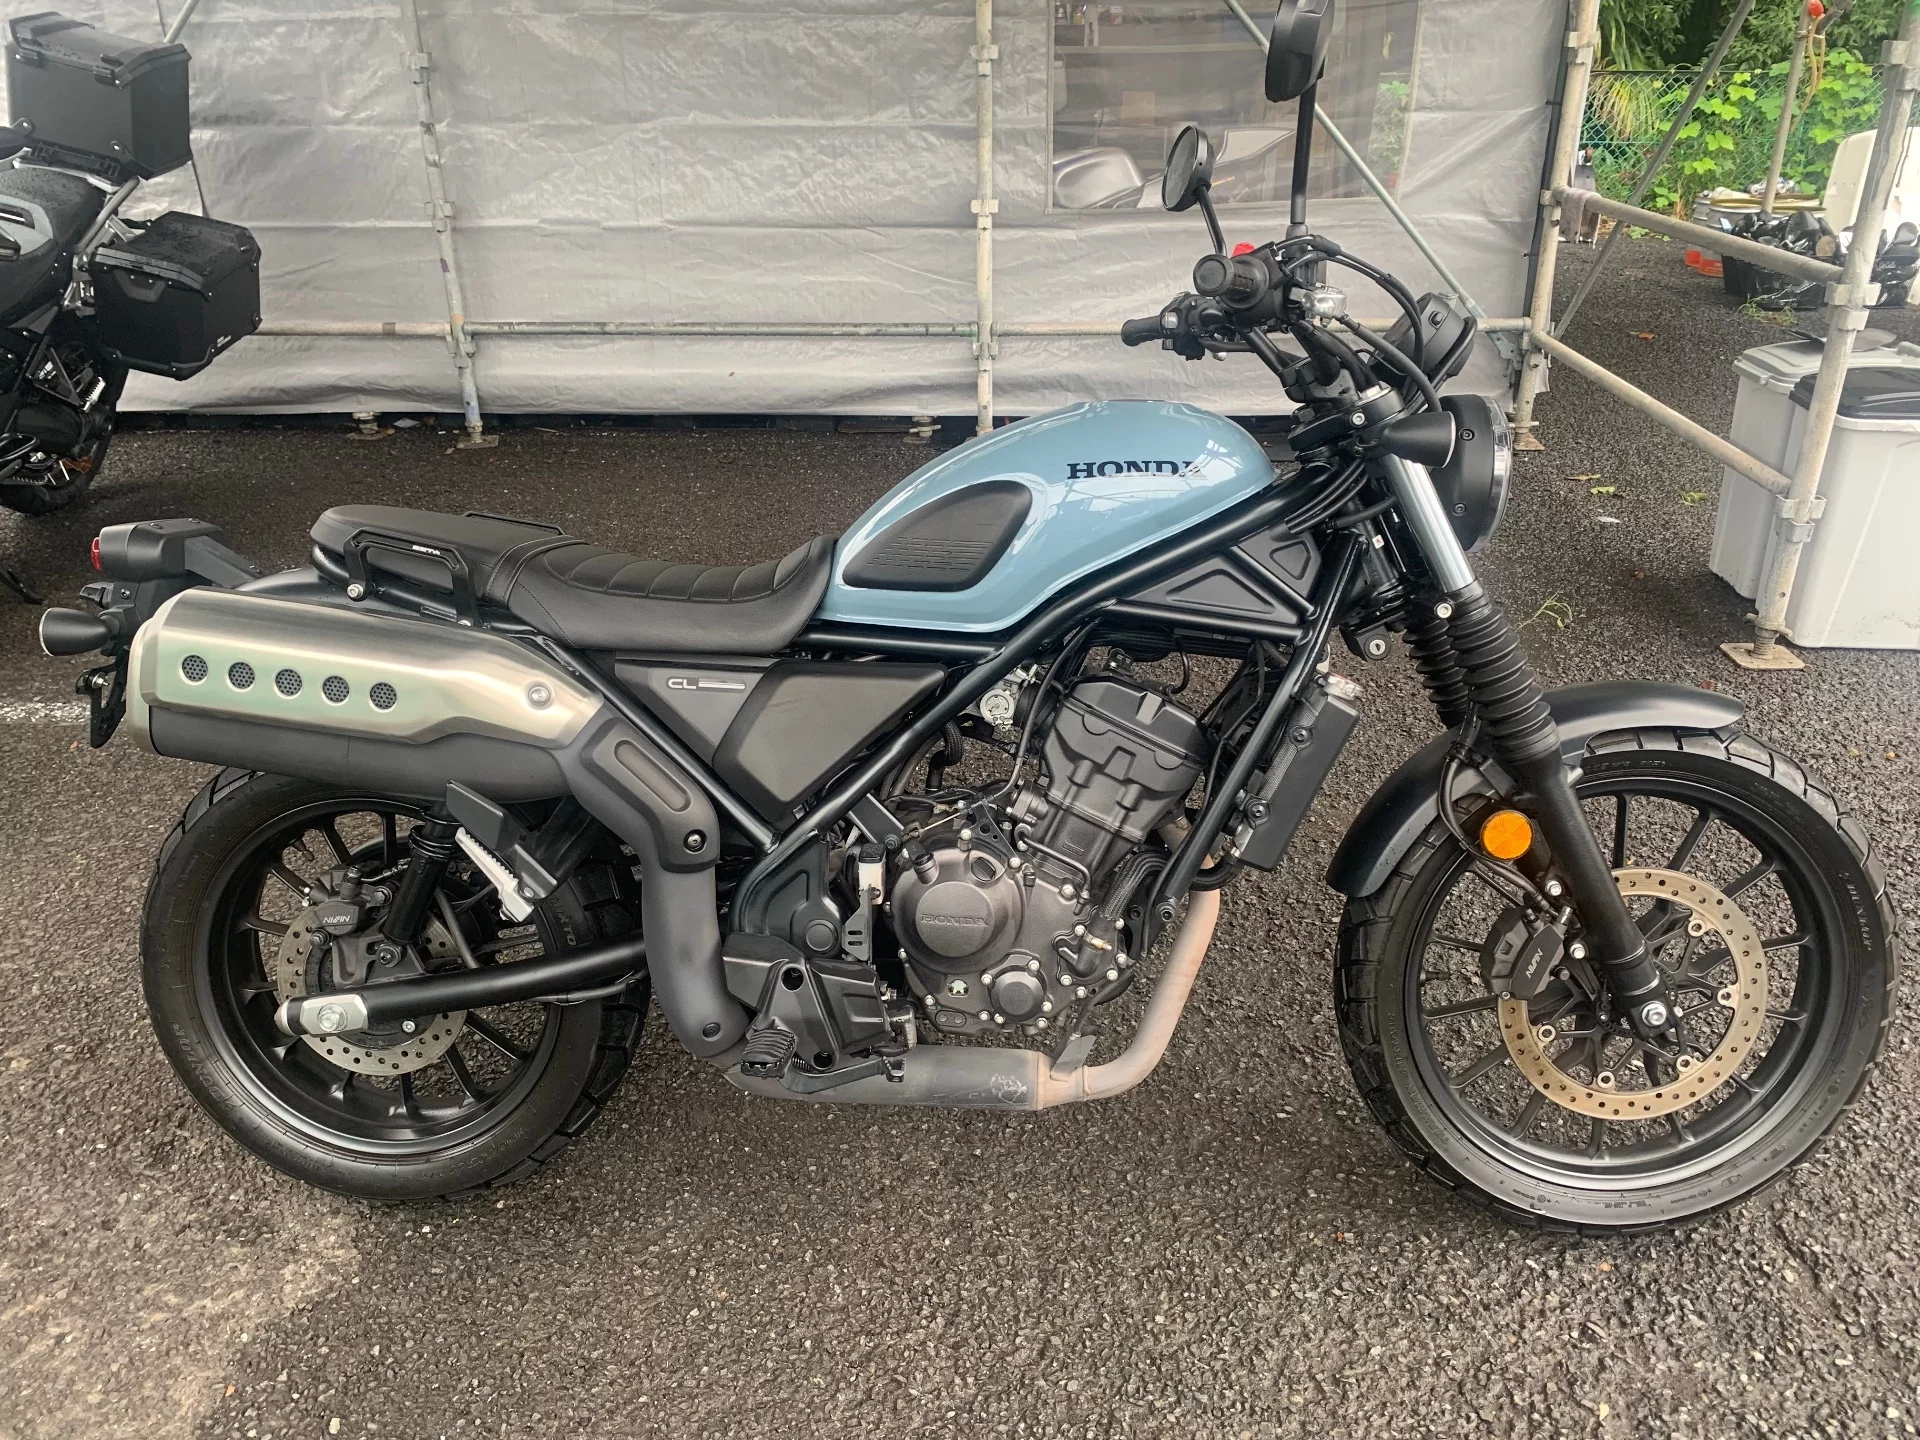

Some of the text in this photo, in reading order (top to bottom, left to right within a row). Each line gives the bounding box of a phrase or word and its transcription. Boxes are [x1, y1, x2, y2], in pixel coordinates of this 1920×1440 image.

[1067, 460, 1206, 479] HONDA
[668, 678, 697, 690] CL
[920, 913, 988, 927] HONDA
